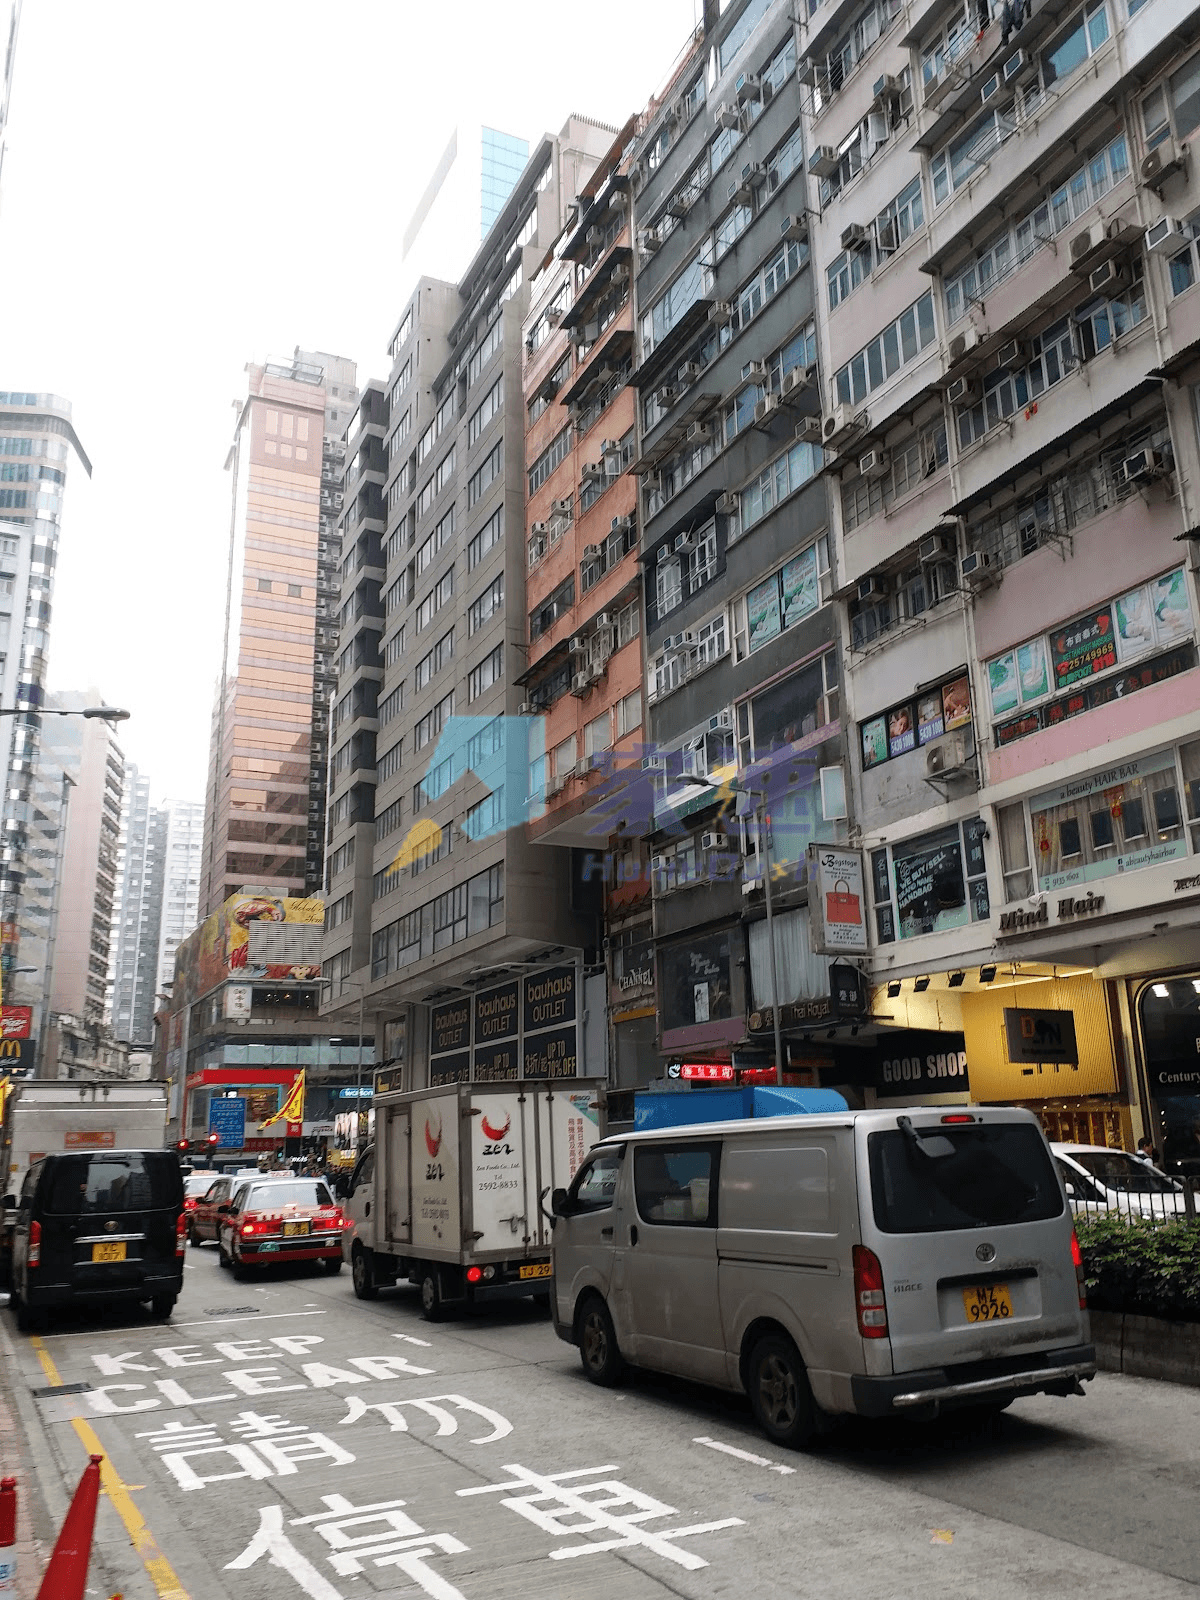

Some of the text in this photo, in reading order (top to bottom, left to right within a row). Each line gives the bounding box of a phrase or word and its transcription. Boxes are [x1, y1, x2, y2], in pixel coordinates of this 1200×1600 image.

[1069, 642, 1113, 670] 25749969
[1066, 781, 1092, 796] beauty
[1094, 770, 1118, 787] HAIR
[1119, 763, 1139, 779] BAR
[900, 878, 912, 890] WE
[911, 851, 947, 880] BUY/SELL
[916, 874, 935, 888] NAME
[899, 883, 933, 909] HANDBAG
[999, 891, 1105, 930] Mind Hair
[527, 975, 571, 1002] bauhaus
[618, 967, 653, 991] CHANNEL
[478, 993, 516, 1018] bauhaus
[533, 998, 566, 1022] OUTLET
[807, 999, 830, 1019] Royal
[435, 1008, 468, 1030] bauhaus
[482, 1014, 511, 1036] OUTLET
[438, 1028, 463, 1047] OUTLET
[547, 1040, 565, 1059] UP TO
[563, 1056, 575, 1075] OFF
[882, 1051, 967, 1082] GOOD SHOP
[522, 1267, 533, 1277] TJ
[893, 1283, 922, 1293] HIACE
[977, 1287, 997, 1304] MZ
[971, 1301, 1009, 1321] 9926
[91, 1334, 326, 1376] KEEP
[83, 1355, 436, 1415] CLEAR
[134, 1394, 514, 1492] 請勿
[223, 1463, 747, 1600] 停車
